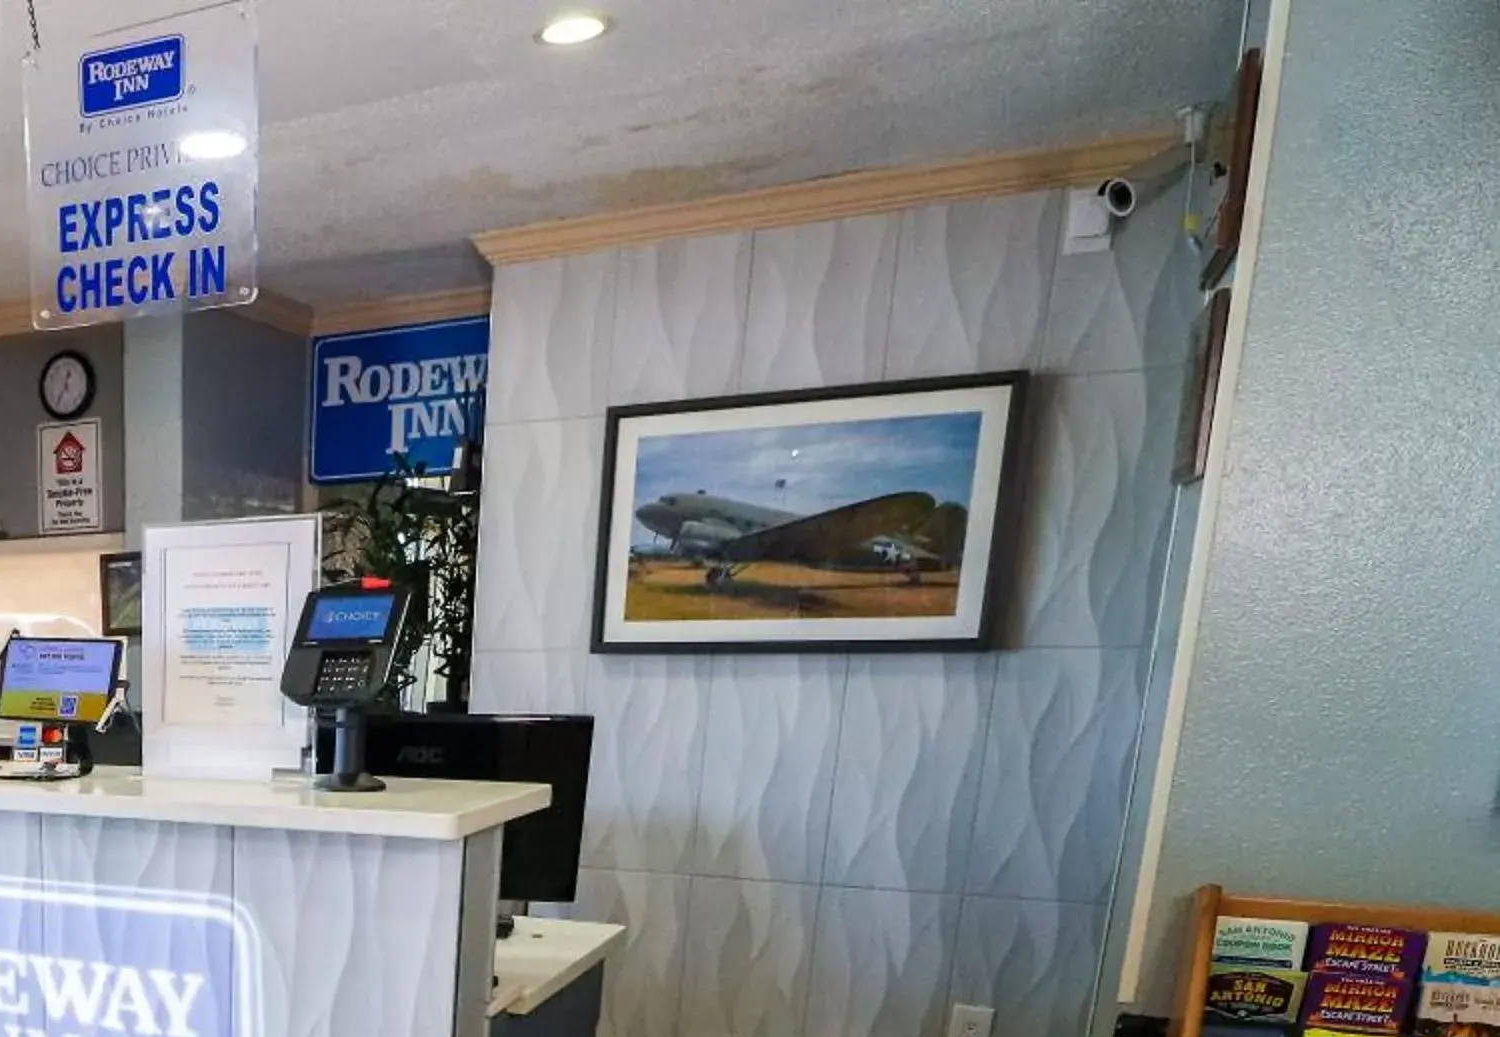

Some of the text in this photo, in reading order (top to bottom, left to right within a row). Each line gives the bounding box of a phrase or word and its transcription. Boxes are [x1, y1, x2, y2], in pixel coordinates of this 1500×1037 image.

[88, 50, 176, 85] RODEWAY
[113, 73, 151, 101] INN
[79, 123, 92, 135] By
[100, 113, 141, 129] Choice
[41, 150, 122, 187] CHOICE
[59, 181, 220, 253] EXPRESS
[56, 244, 226, 313] CHECK IN
[1325, 943, 1401, 962] MAZE
[1210, 990, 1285, 1008] ANTONIO
[1234, 979, 1267, 993] SAN
